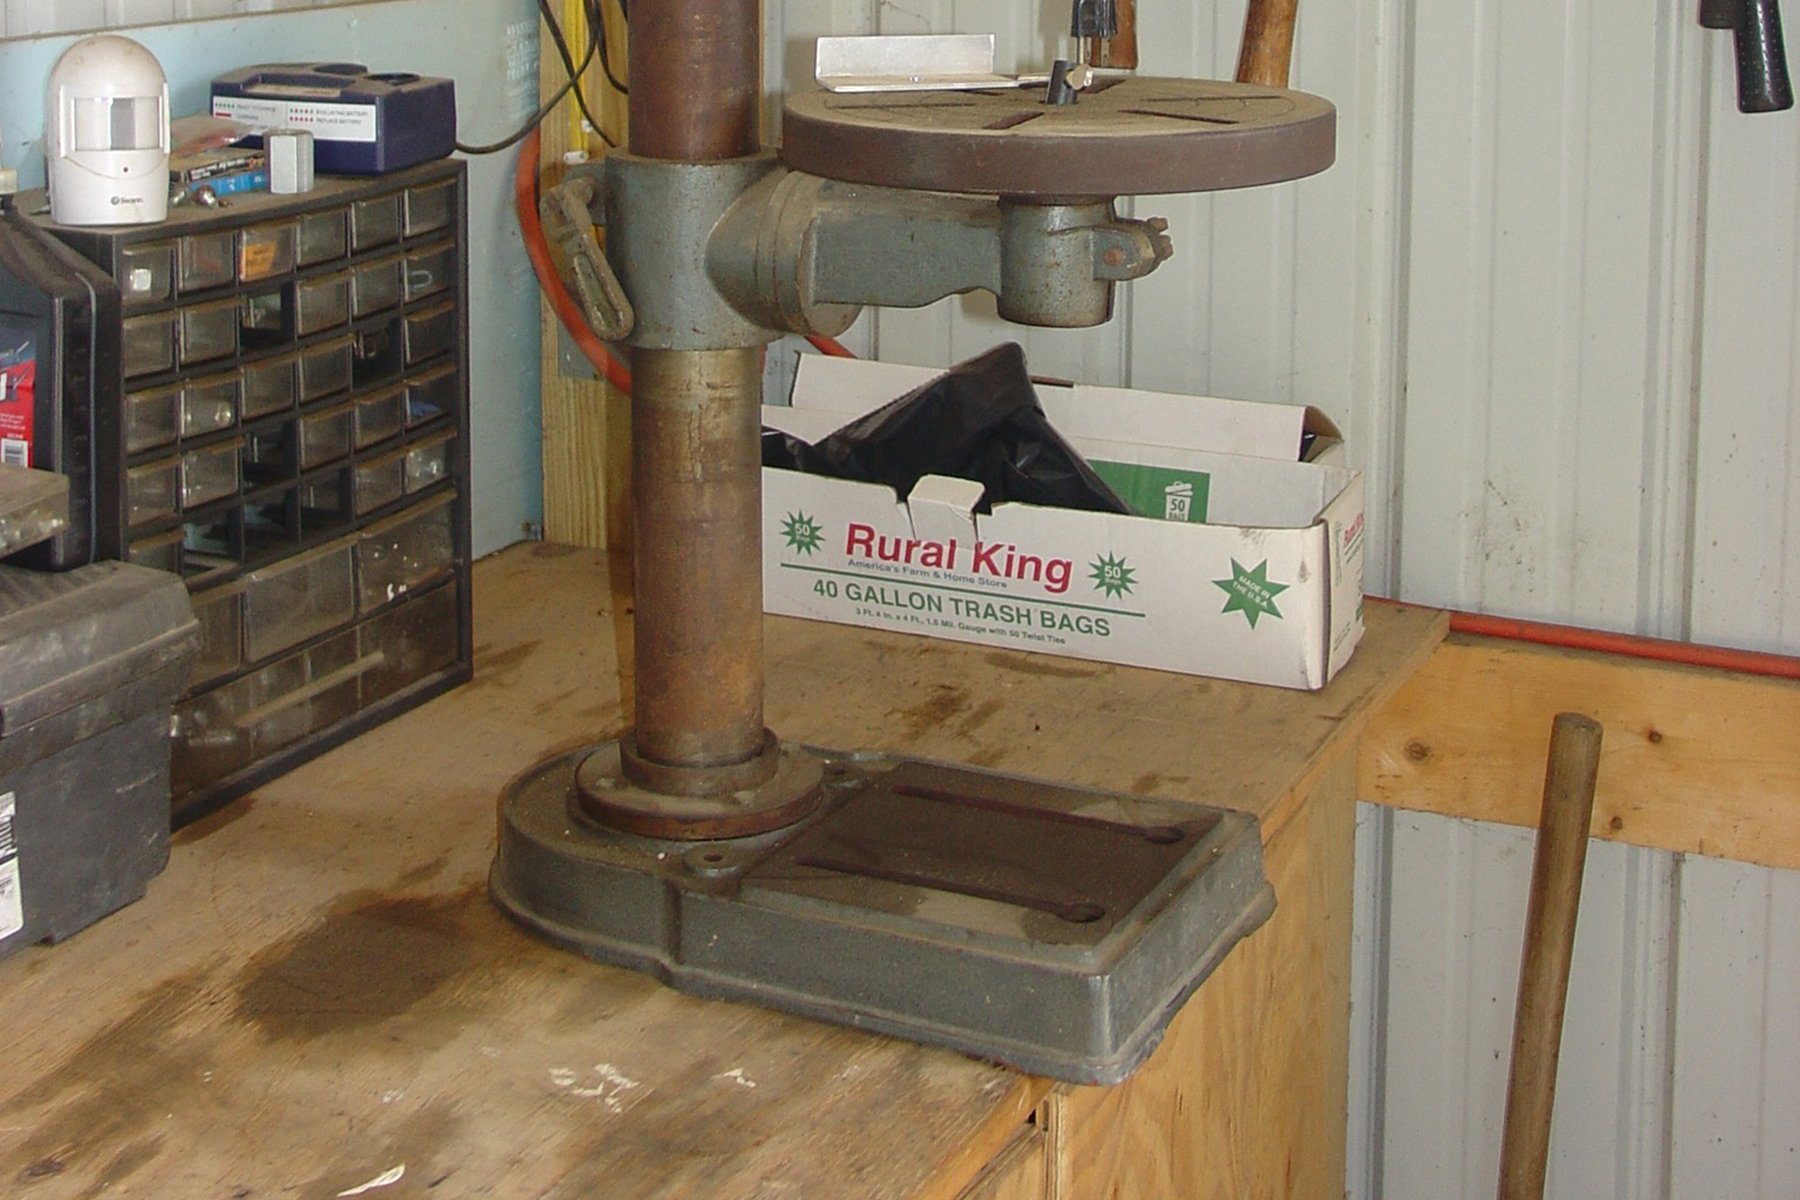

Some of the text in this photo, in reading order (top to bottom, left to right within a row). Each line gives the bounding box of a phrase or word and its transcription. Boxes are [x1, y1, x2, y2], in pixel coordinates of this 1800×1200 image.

[1170, 499, 1186, 512] 50
[795, 523, 811, 536] 50
[846, 523, 1072, 594] Rural King
[848, 559, 1008, 589] America's Farm & Home Store
[1104, 566, 1122, 579] 50
[1232, 580, 1248, 596] THE
[1238, 575, 1272, 600] MADE IN
[813, 579, 1111, 637] 40 GALLON TRASH BAGS
[863, 609, 873, 617] Ft.
[876, 610, 881, 618] 4
[903, 614, 908, 622] 4
[958, 622, 987, 634] Gauge
[989, 627, 1007, 636] with
[1009, 629, 1020, 638] 50
[1022, 631, 1045, 641] Twist
[1047, 635, 1066, 644] Ties
